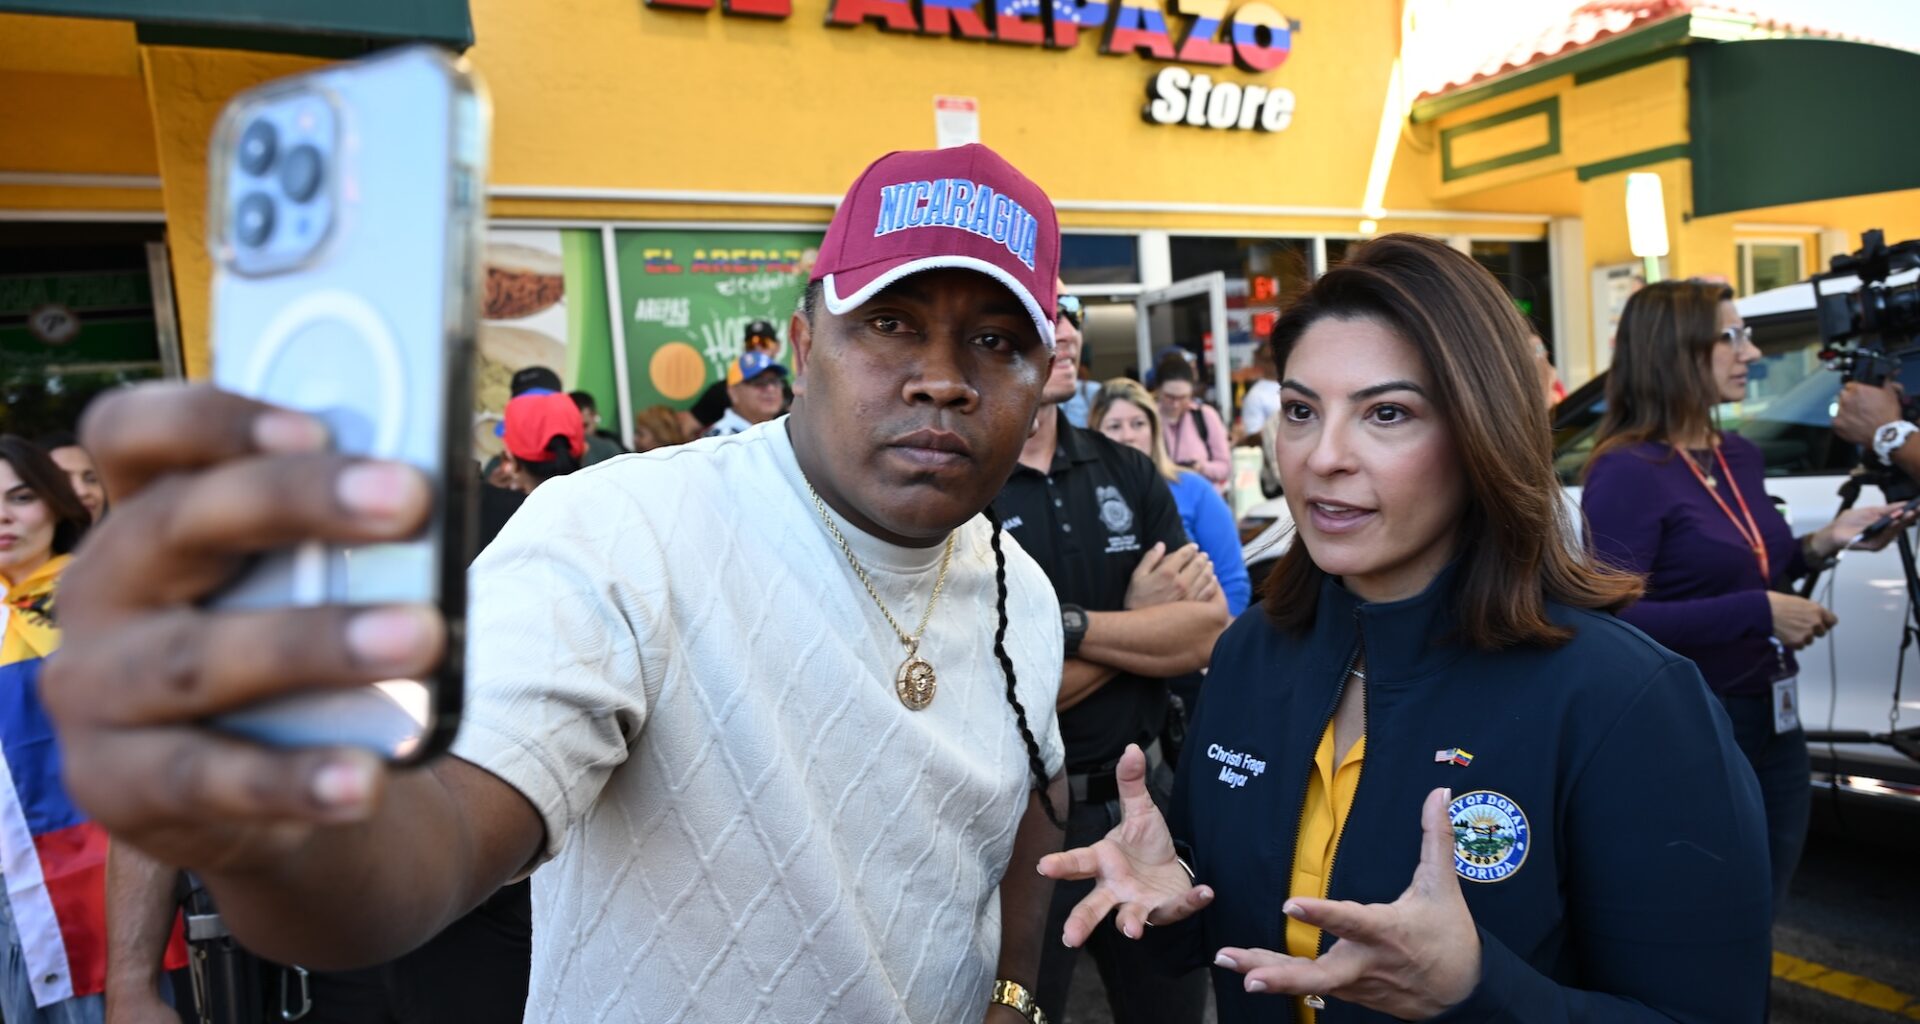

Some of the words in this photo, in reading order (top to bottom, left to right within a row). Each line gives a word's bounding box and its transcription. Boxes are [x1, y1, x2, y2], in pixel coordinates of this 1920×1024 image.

[1148, 66, 1296, 132] Store
[874, 178, 1038, 272] NICARAGUA
[643, 248, 683, 273] EL
[1207, 743, 1244, 767] Christi
[1241, 753, 1267, 777] Fraga
[1218, 765, 1249, 788] Mayor
[1466, 794, 1484, 806] OF
[1487, 794, 1526, 834] DORAL
